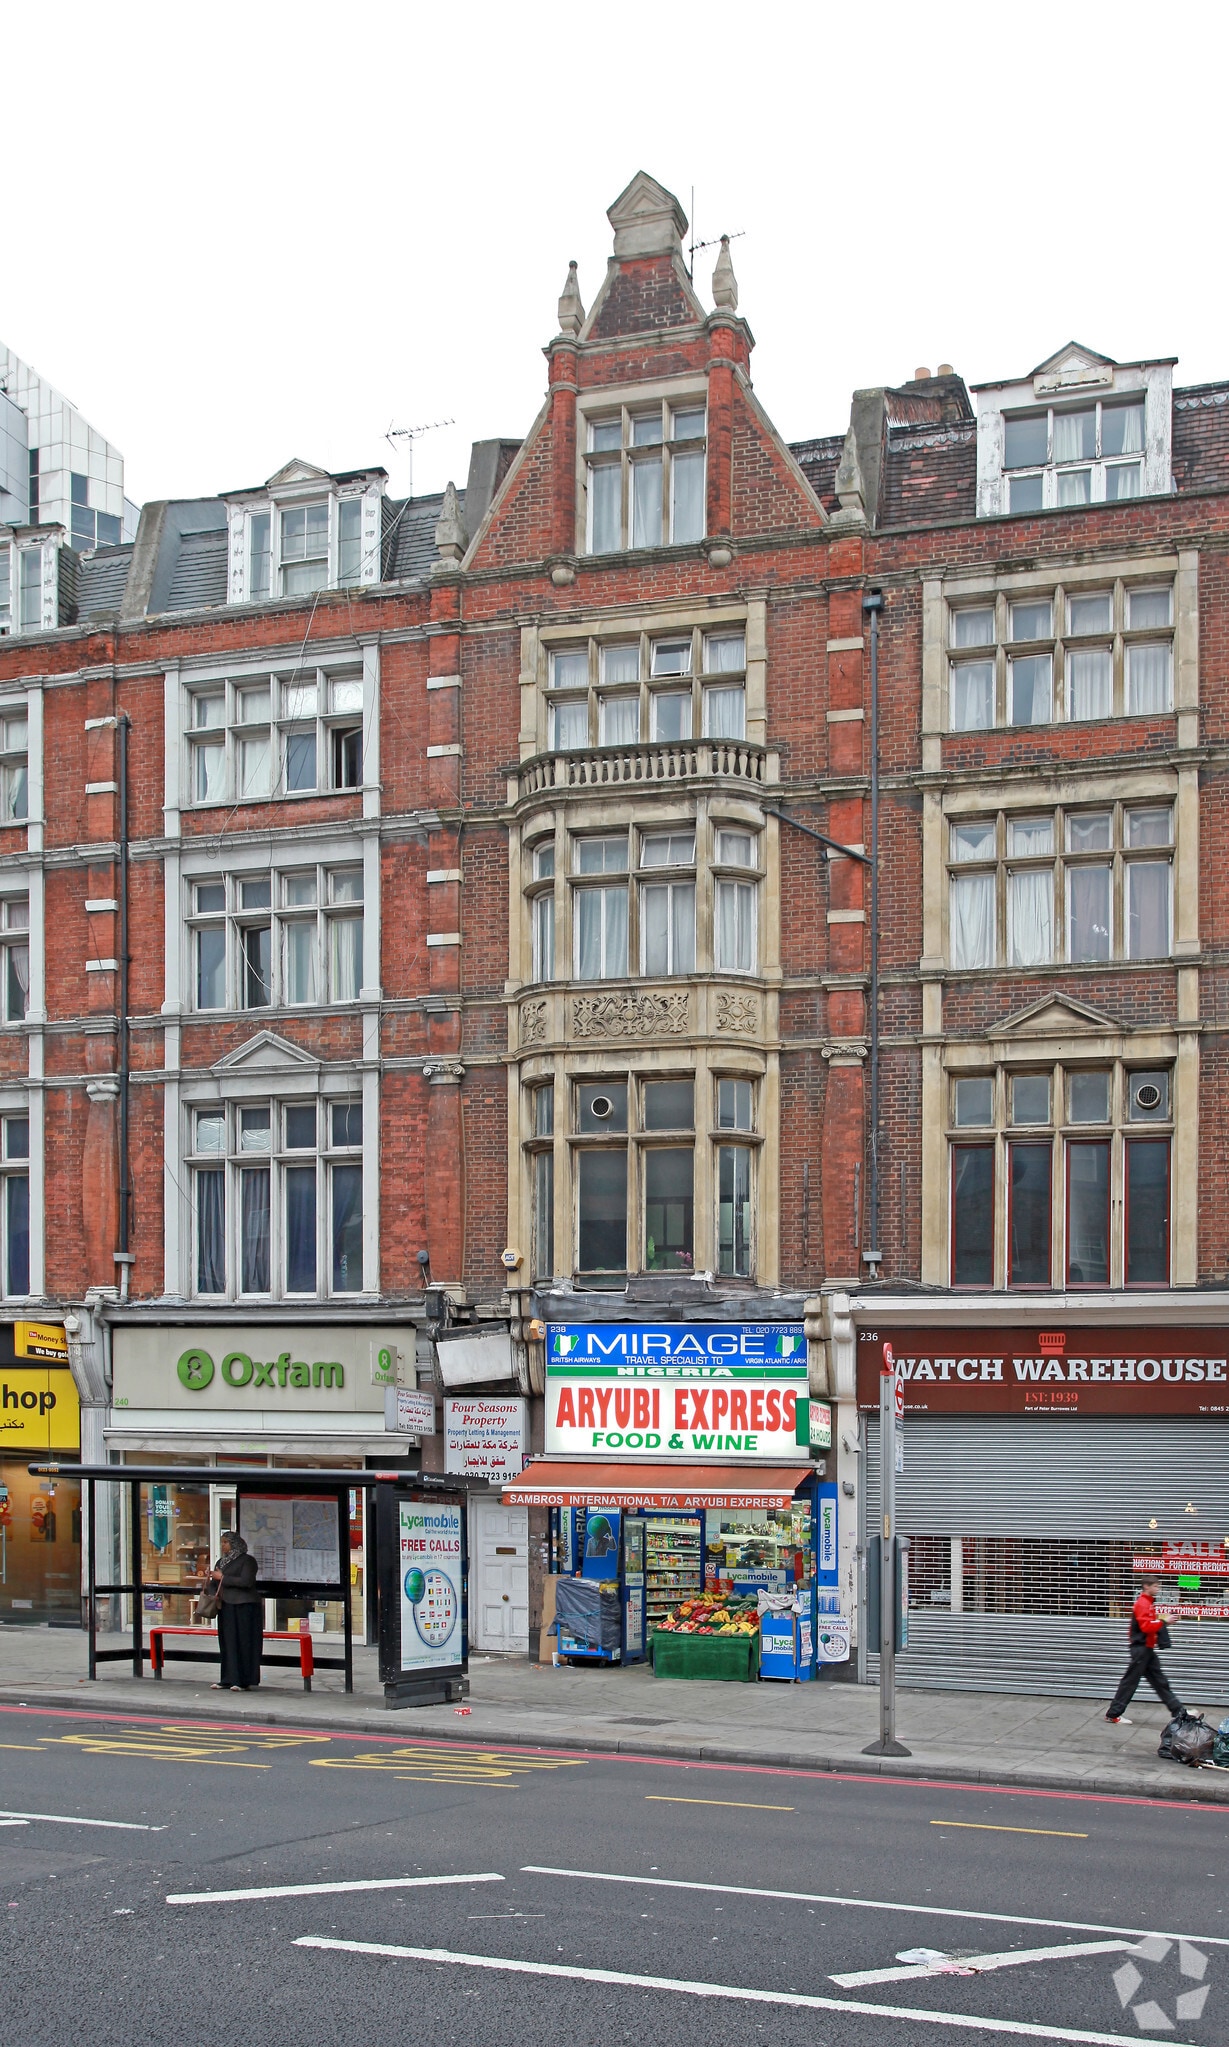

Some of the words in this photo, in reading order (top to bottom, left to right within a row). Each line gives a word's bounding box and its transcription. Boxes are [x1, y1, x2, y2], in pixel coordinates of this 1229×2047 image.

[742, 1326, 756, 1334] TEL:
[756, 1326, 770, 1334] 020
[771, 1326, 788, 1334] 7723
[38, 1334, 59, 1345] Money
[860, 1332, 879, 1341] 236
[587, 1333, 765, 1355] MIRAGE
[35, 1347, 45, 1355] We
[46, 1348, 56, 1358] buy
[625, 1356, 658, 1365] TRAVEL
[660, 1356, 708, 1365] SPECIALIST
[711, 1357, 724, 1365] TO
[221, 1351, 345, 1388] Oxfam
[617, 1367, 734, 1377] NIGERIA
[891, 1358, 1004, 1381] WATCH
[1012, 1358, 1227, 1381] WAREHOUSE
[375, 1371, 394, 1383] Oxfam
[2, 1384, 57, 1416] hop
[114, 1398, 129, 1406] 240
[1051, 1392, 1079, 1402] 1939
[451, 1402, 476, 1412] Four
[477, 1402, 518, 1412] Seasons
[556, 1387, 660, 1429] ARYUBI
[674, 1388, 798, 1432] EXPRESS
[462, 1414, 507, 1428] Property
[448, 1428, 468, 1437] Property
[468, 1428, 485, 1437] Letting
[490, 1429, 520, 1437] Management
[450, 1440, 480, 1450] للعقارات
[482, 1440, 496, 1449] مكة
[498, 1440, 518, 1452] شركة
[592, 1432, 661, 1449] FOOD
[668, 1433, 684, 1450] &
[692, 1434, 758, 1451] WINE
[490, 1456, 506, 1468] شقق
[509, 1494, 564, 1504] SAMBROS
[569, 1496, 658, 1506] INTERNATIONAL
[660, 1496, 678, 1506] T/A
[684, 1497, 727, 1507] ARYUBI
[730, 1498, 784, 1508] EXPRESS
[401, 1512, 459, 1530] Lycamobile
[823, 1506, 832, 1562] Lycamobile
[401, 1538, 426, 1552] FREE
[429, 1539, 460, 1552] CALLS
[1167, 1541, 1221, 1557] SALE
[1169, 1560, 1201, 1571] FURTHER
[727, 1572, 778, 1581] Lycamobile
[1155, 1606, 1200, 1615] EVERYTHING
[774, 1638, 794, 1646] Lyca
